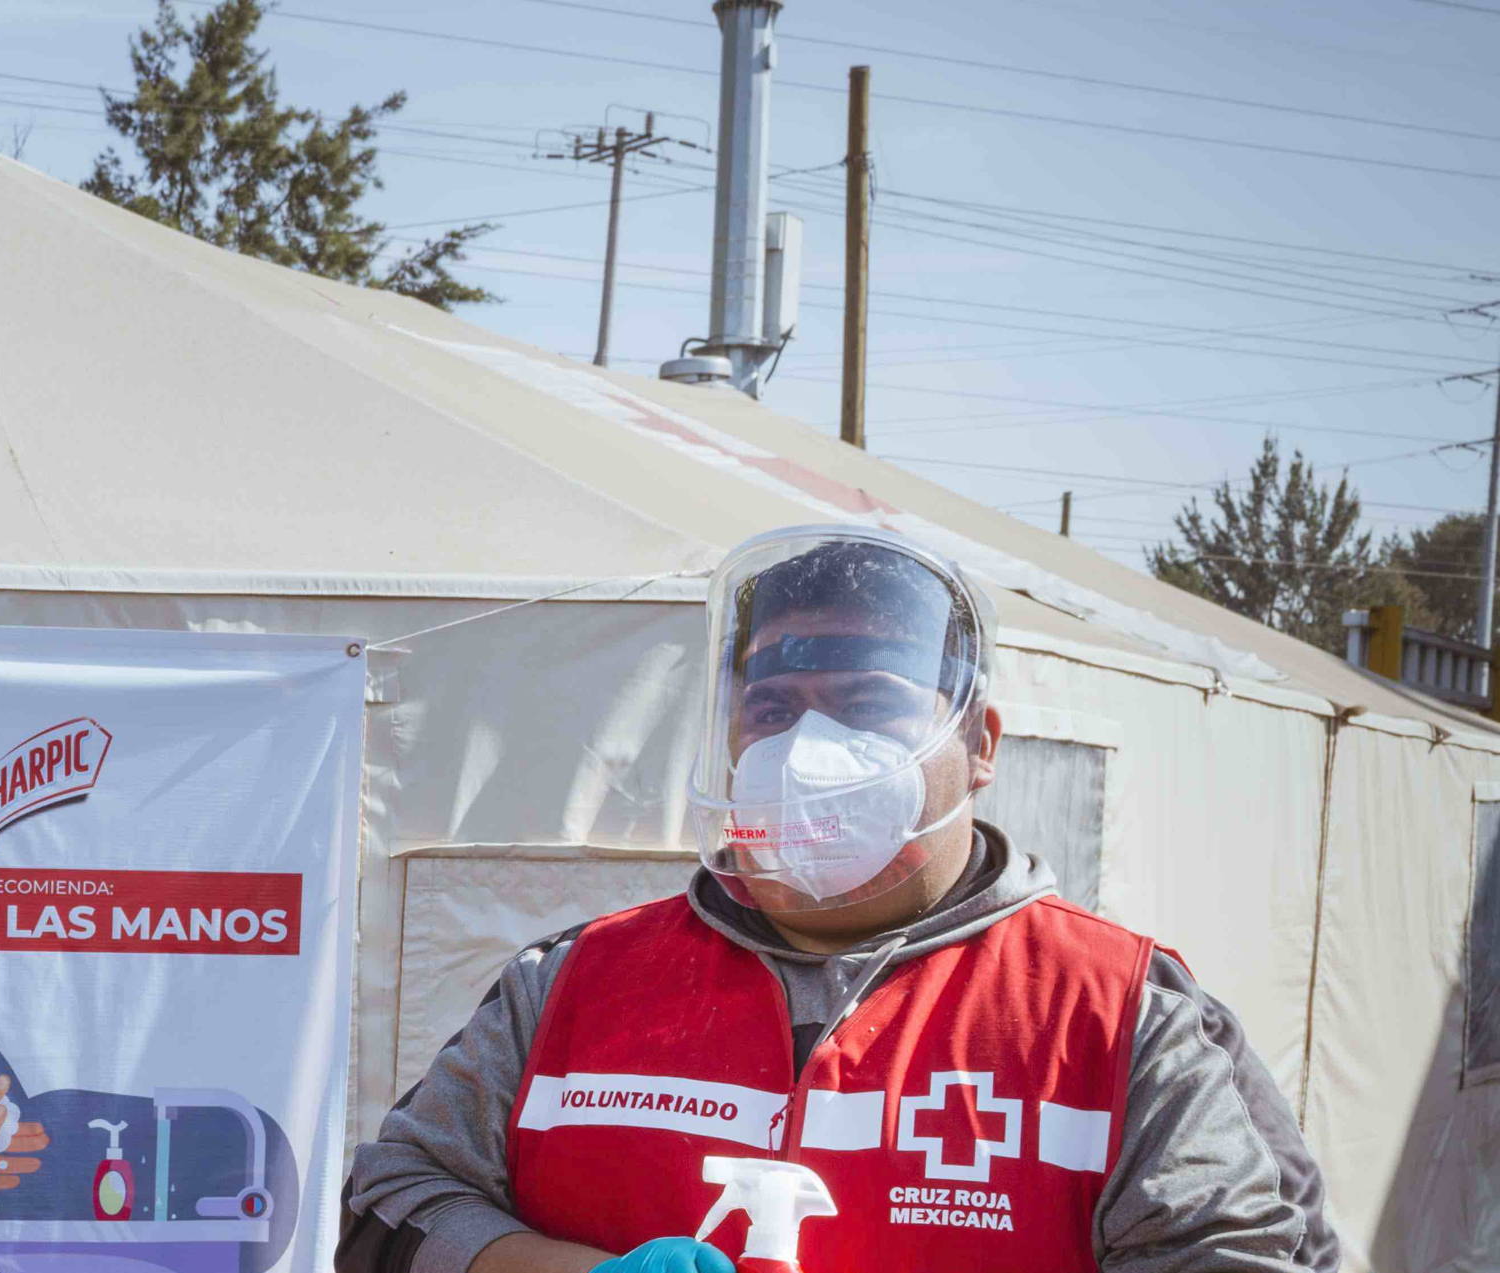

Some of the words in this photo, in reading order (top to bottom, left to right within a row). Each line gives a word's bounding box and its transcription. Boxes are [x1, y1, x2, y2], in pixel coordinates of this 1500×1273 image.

[6, 904, 98, 940] LAS
[110, 906, 289, 944] MANOS
[560, 1089, 740, 1122] VOLUNTARIADO
[888, 1186, 951, 1206] CRUZ
[954, 1189, 1012, 1211] ROJA
[889, 1207, 1014, 1232] MEXICANA
